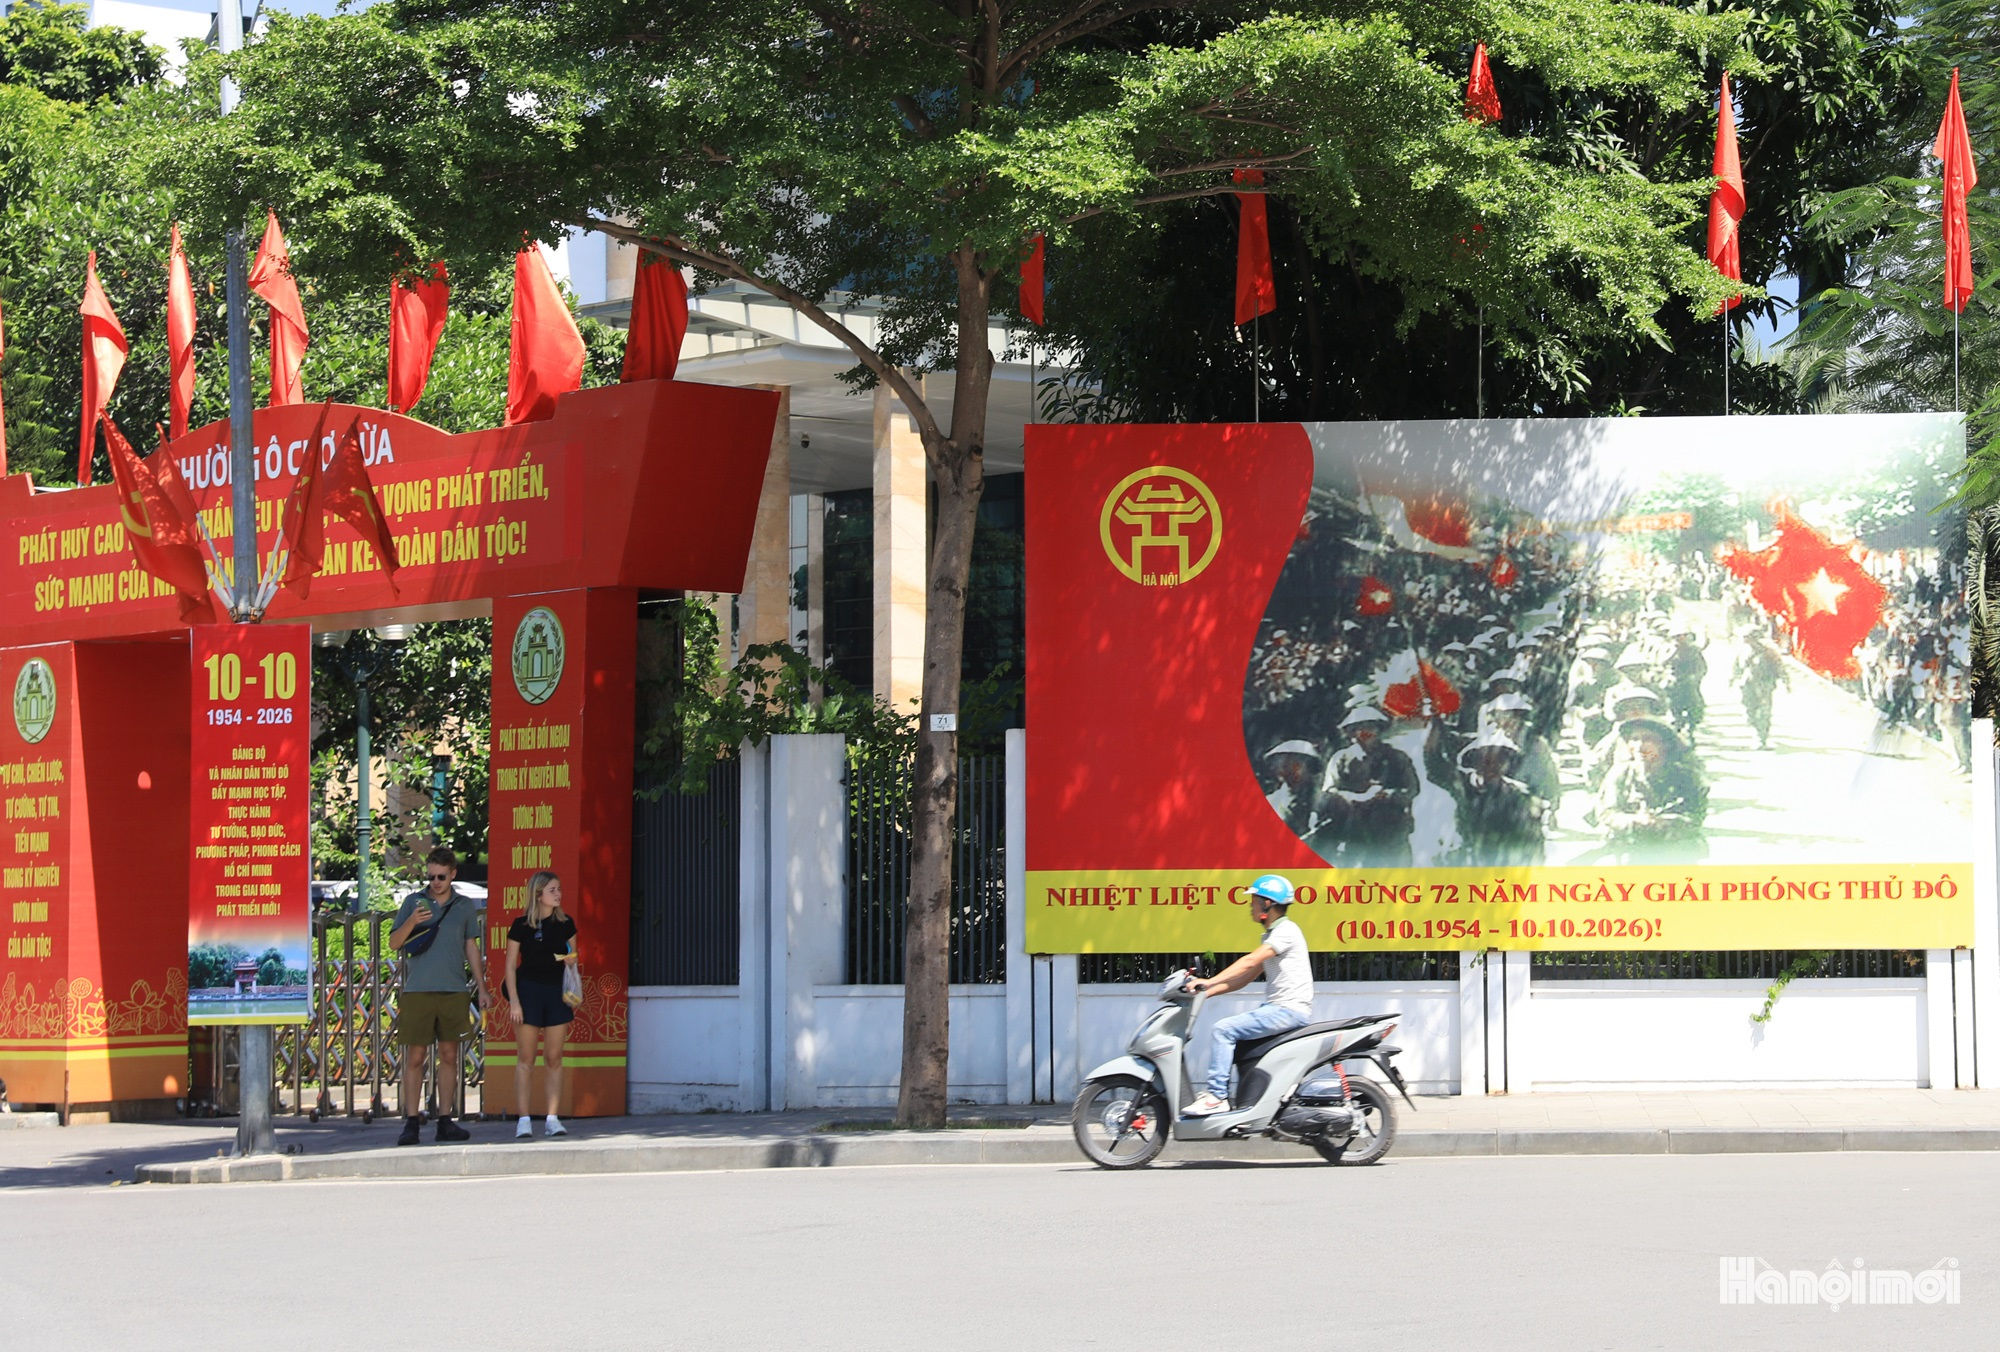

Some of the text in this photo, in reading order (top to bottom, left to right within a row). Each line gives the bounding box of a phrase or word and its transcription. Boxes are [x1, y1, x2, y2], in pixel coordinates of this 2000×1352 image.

[265, 434, 283, 479] Ô
[342, 421, 395, 467] ỪA
[19, 526, 57, 566] PHÁT
[61, 526, 90, 560] HUY
[94, 521, 124, 555] CAO
[383, 478, 432, 523] VỌNG
[436, 466, 485, 510] PHÁT
[489, 451, 549, 501] TRIỂN,
[34, 574, 65, 612] SỨC
[69, 572, 114, 613] MẠNH
[118, 558, 149, 602] CỦA
[312, 537, 347, 578] ÀN
[441, 521, 479, 563] DÂN
[485, 516, 527, 564] TỘC!
[1143, 571, 1178, 589] HÀ NỘI
[207, 709, 242, 725] 1954
[257, 707, 293, 724] 2026
[499, 723, 516, 752] PHÁT
[517, 717, 536, 751] TRIỂN
[549, 724, 570, 752] NGOẠI
[232, 744, 266, 762] ĐẢNG BỘ
[209, 762, 289, 780] VÀ NHÂN DÂN THỦ ĐÔ
[497, 767, 518, 791] TRONG
[528, 760, 555, 789] NGUYÊN
[211, 782, 287, 802] ĐẨY MẠNH HỌC TẬP,
[228, 803, 271, 821] THỰC HÀNH
[210, 822, 286, 841] TƯ TƯỞNG, ĐẠO ĐỨC,
[196, 841, 301, 859] PHƯƠNG PHÁP, PHONG CÁCH
[224, 861, 272, 877] HỒ CHÍ MINH
[216, 883, 281, 899] TRONG GIAI ĐOẠN
[1046, 873, 1957, 912] NHIỆT LIỆT CO MỪNG 72 NĂM NGÀY GIẢI PHÓNG THỦ ĐÔ
[216, 901, 236, 917] PHÁT
[238, 898, 260, 917] TRIỂN
[1336, 919, 1481, 943] (10.10.1954
[1508, 918, 1662, 942] 10.10.2026)!
